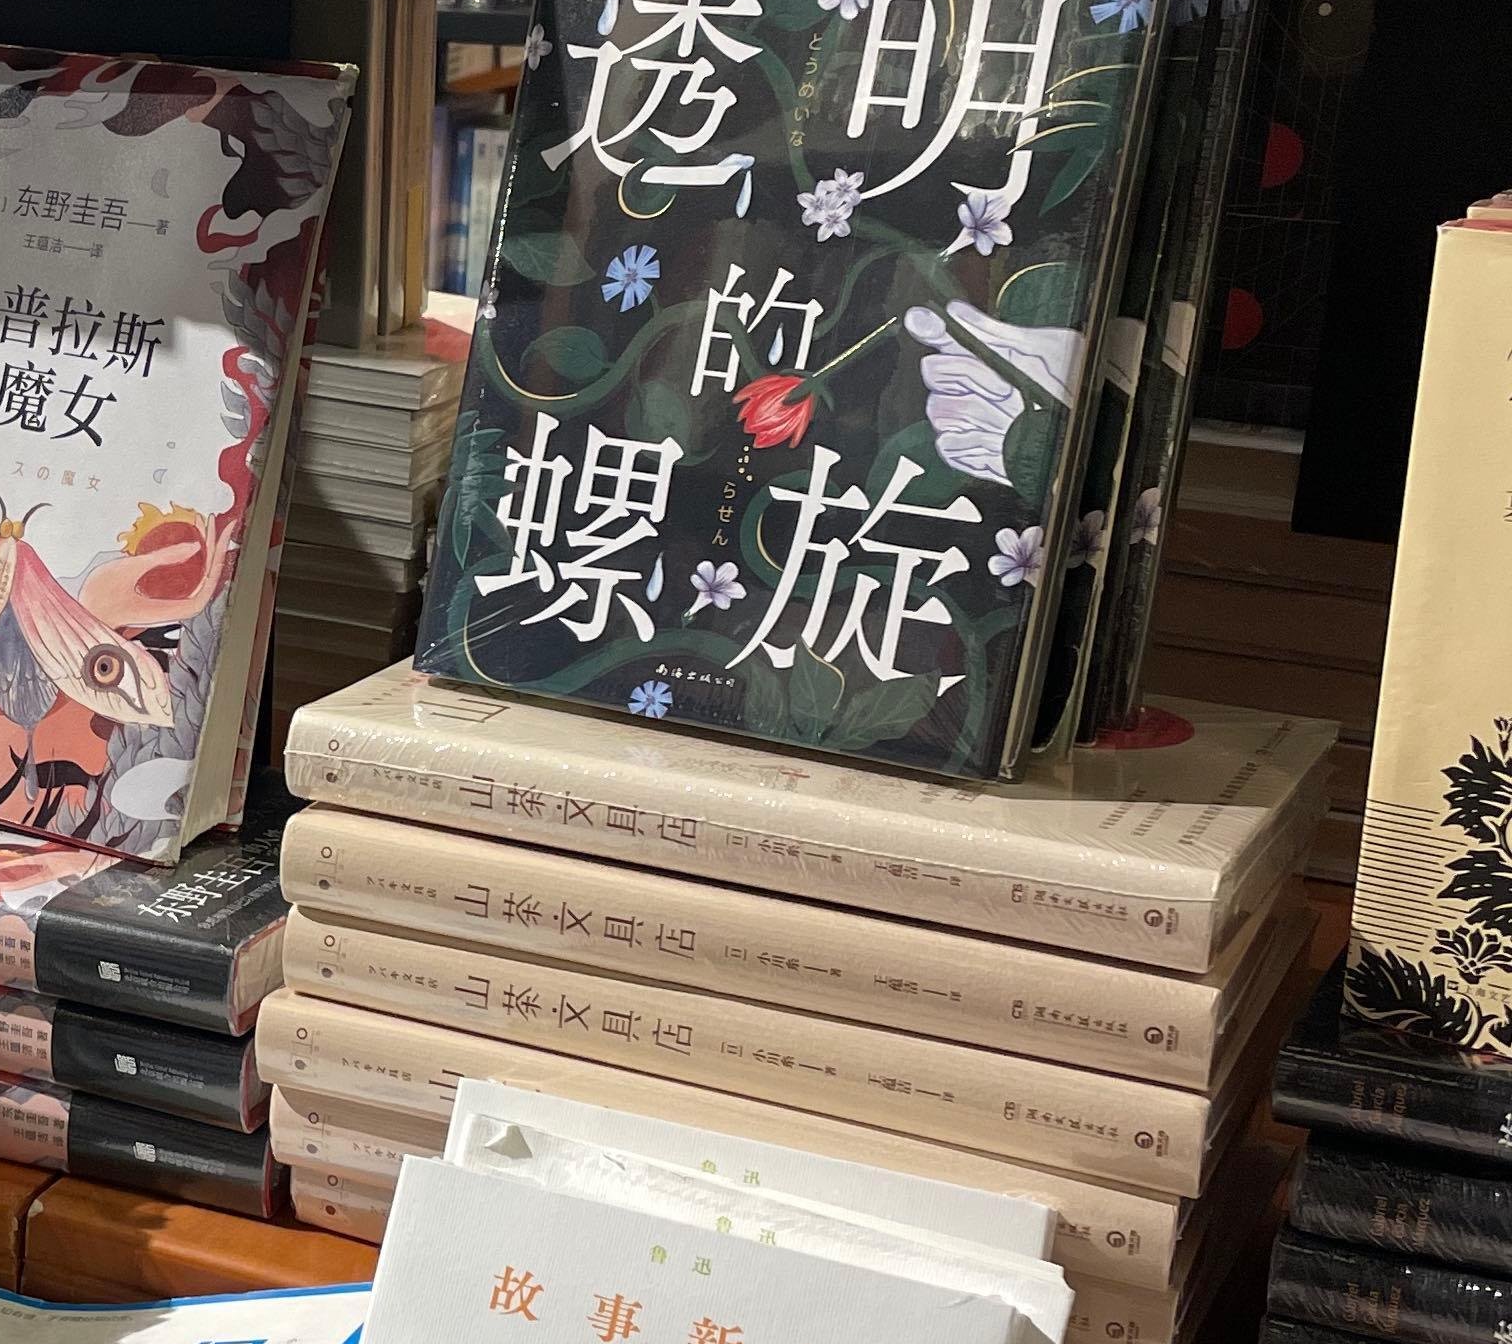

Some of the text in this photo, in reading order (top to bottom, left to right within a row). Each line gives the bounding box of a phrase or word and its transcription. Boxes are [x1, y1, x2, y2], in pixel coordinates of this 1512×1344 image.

[787, 31, 826, 150] とうめいな
[690, 263, 825, 398] 的
[711, 478, 739, 551] らせん
[473, 412, 983, 699] 螺旋
[459, 775, 700, 848] 山茶文具店
[454, 882, 699, 960] 山茶文具店
[454, 974, 694, 1057] 山茶文具店
[700, 1158, 762, 1188] 鲁迅
[647, 1243, 713, 1278] 鲁迅
[714, 1213, 777, 1246] 鲁迅
